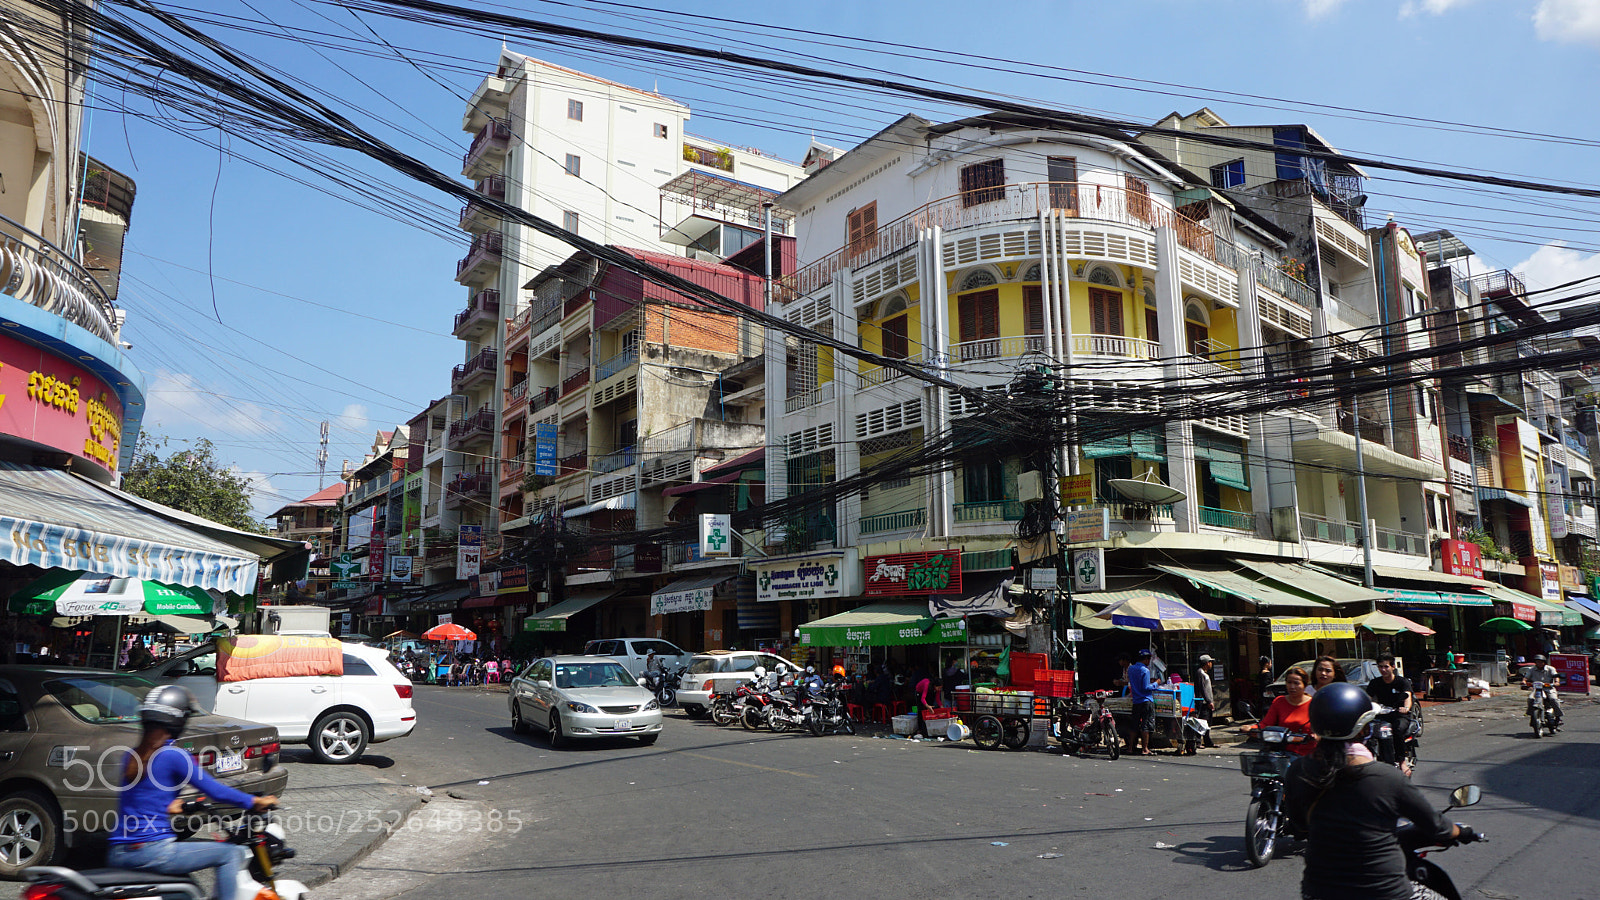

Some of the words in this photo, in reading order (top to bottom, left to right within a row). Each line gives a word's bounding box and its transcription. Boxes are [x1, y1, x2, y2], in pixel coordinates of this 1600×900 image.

[771, 582, 801, 590] PHARMACIE
[66, 601, 95, 612] Focus
[99, 602, 119, 611] 4G
